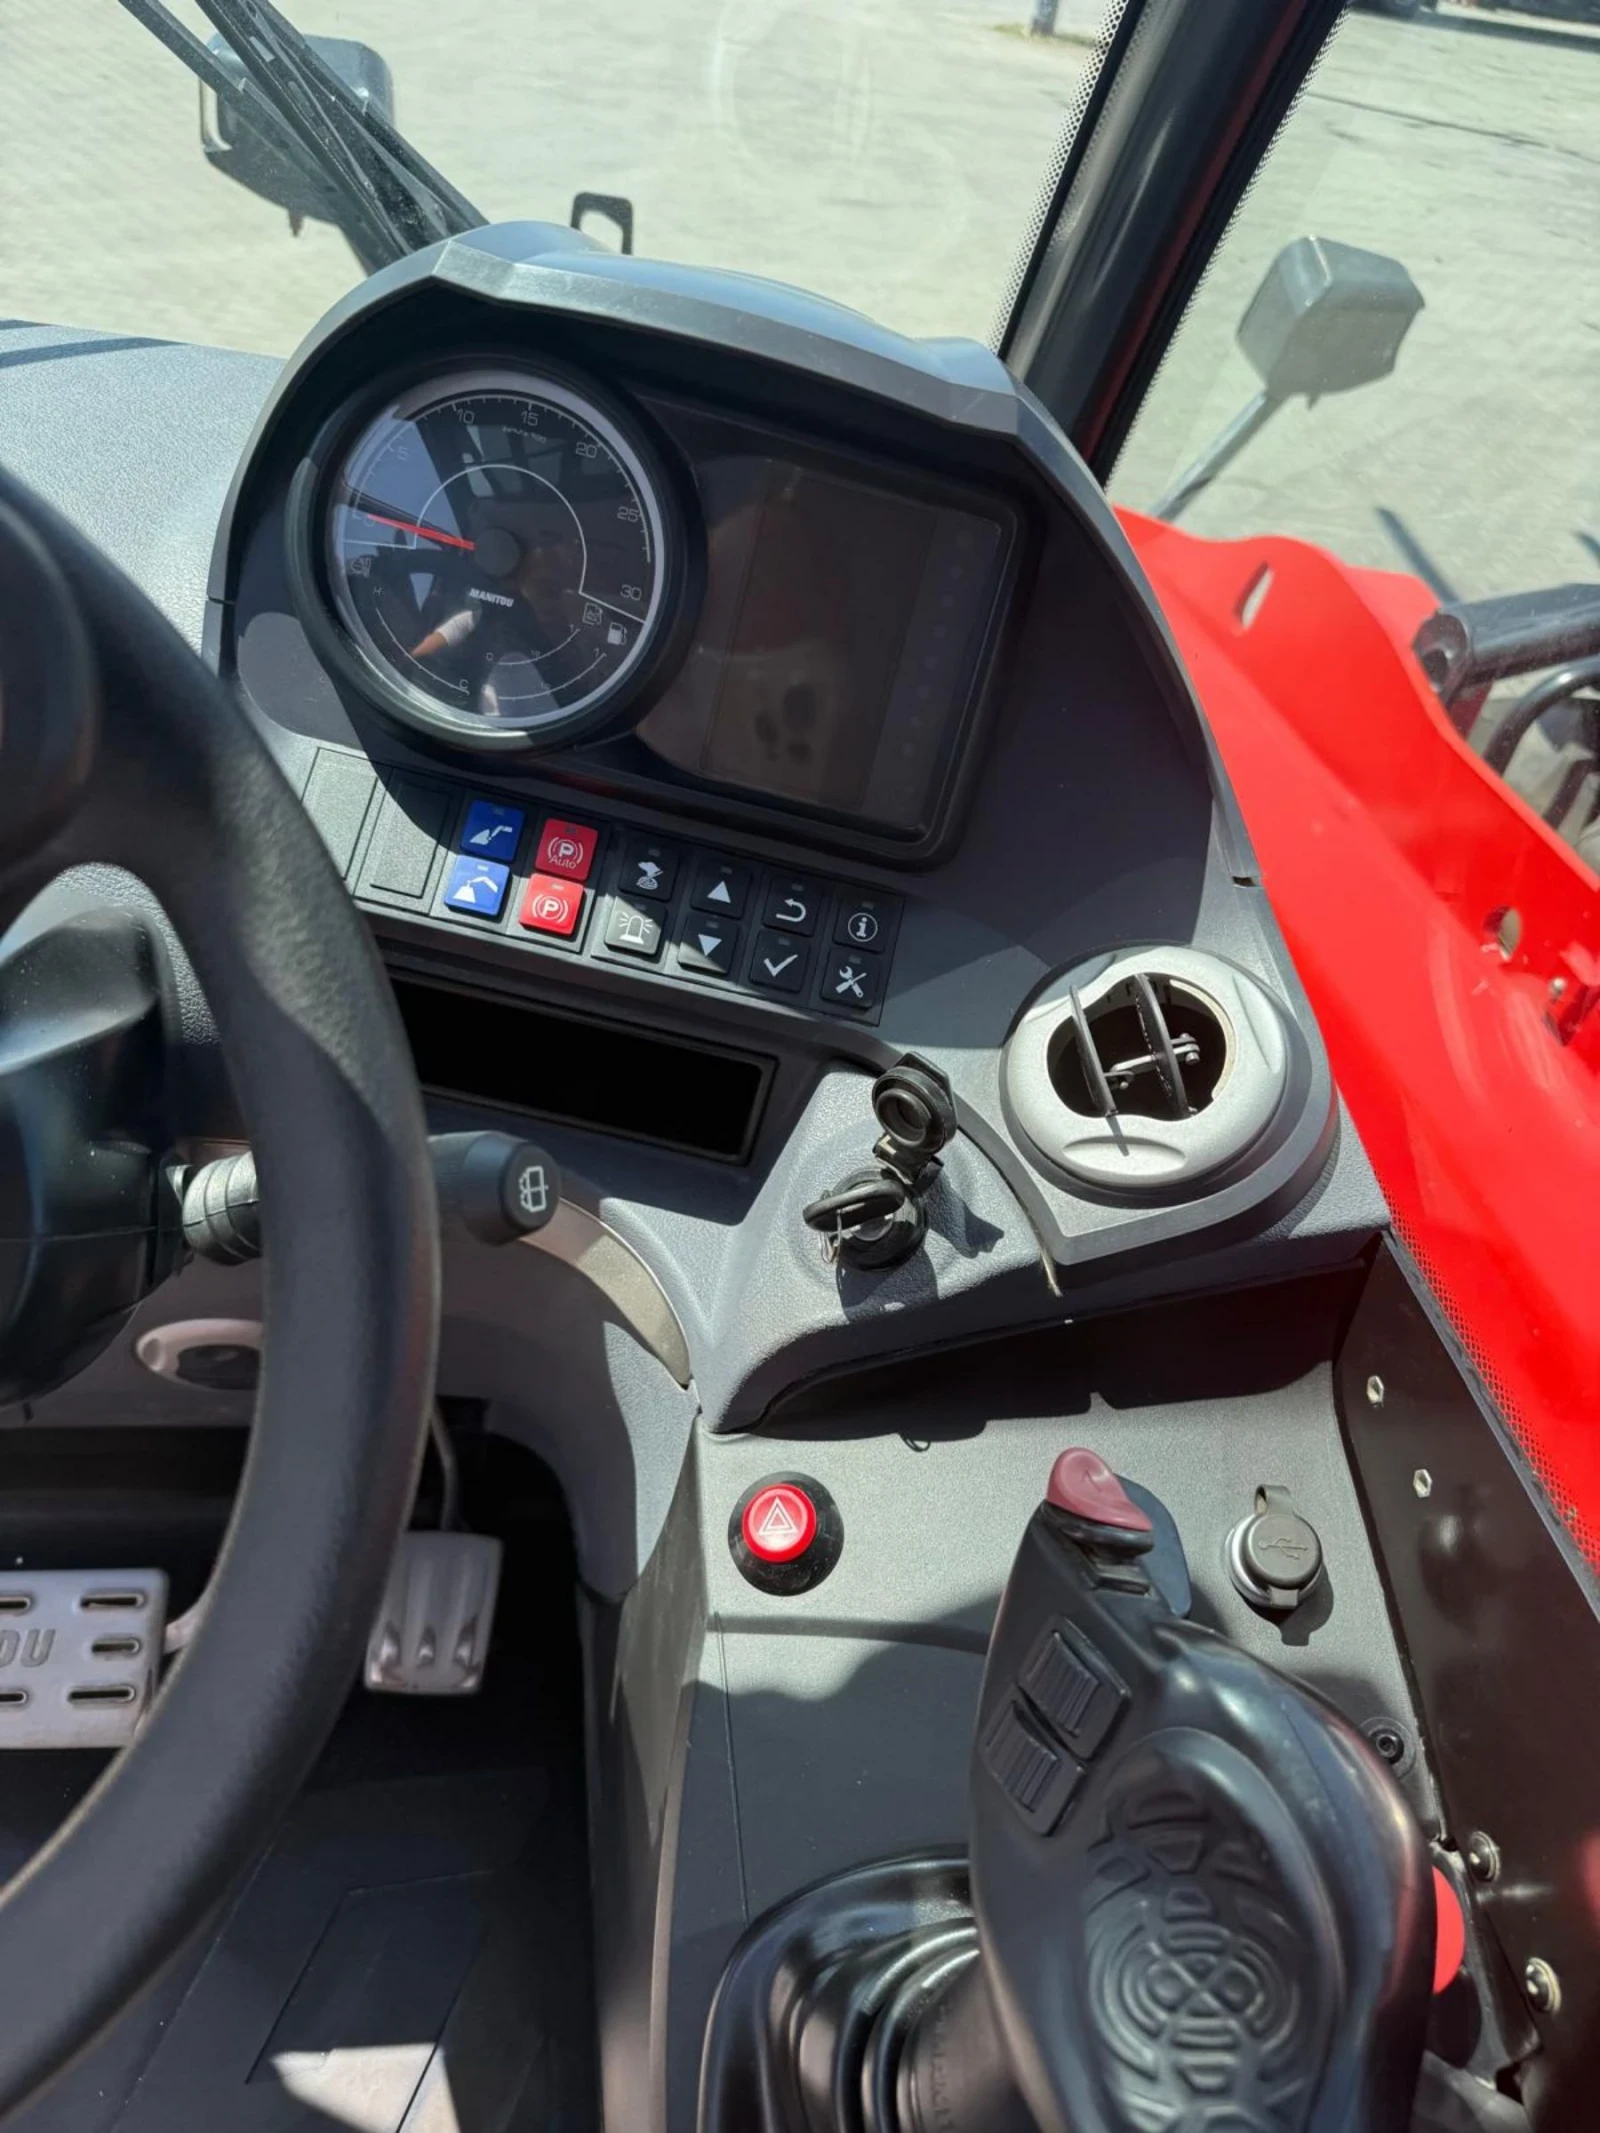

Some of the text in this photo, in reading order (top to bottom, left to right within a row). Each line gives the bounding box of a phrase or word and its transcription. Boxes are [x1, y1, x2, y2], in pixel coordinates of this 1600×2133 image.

[457, 410, 475, 426] 10
[520, 410, 539, 426] 15
[397, 446, 408, 460] 5
[576, 442, 597, 459] 20
[617, 506, 639, 522] 25
[468, 587, 515, 608] MANITOU
[620, 584, 642, 601] 30
[549, 855, 577, 870] Auto
[542, 899, 559, 916] P
